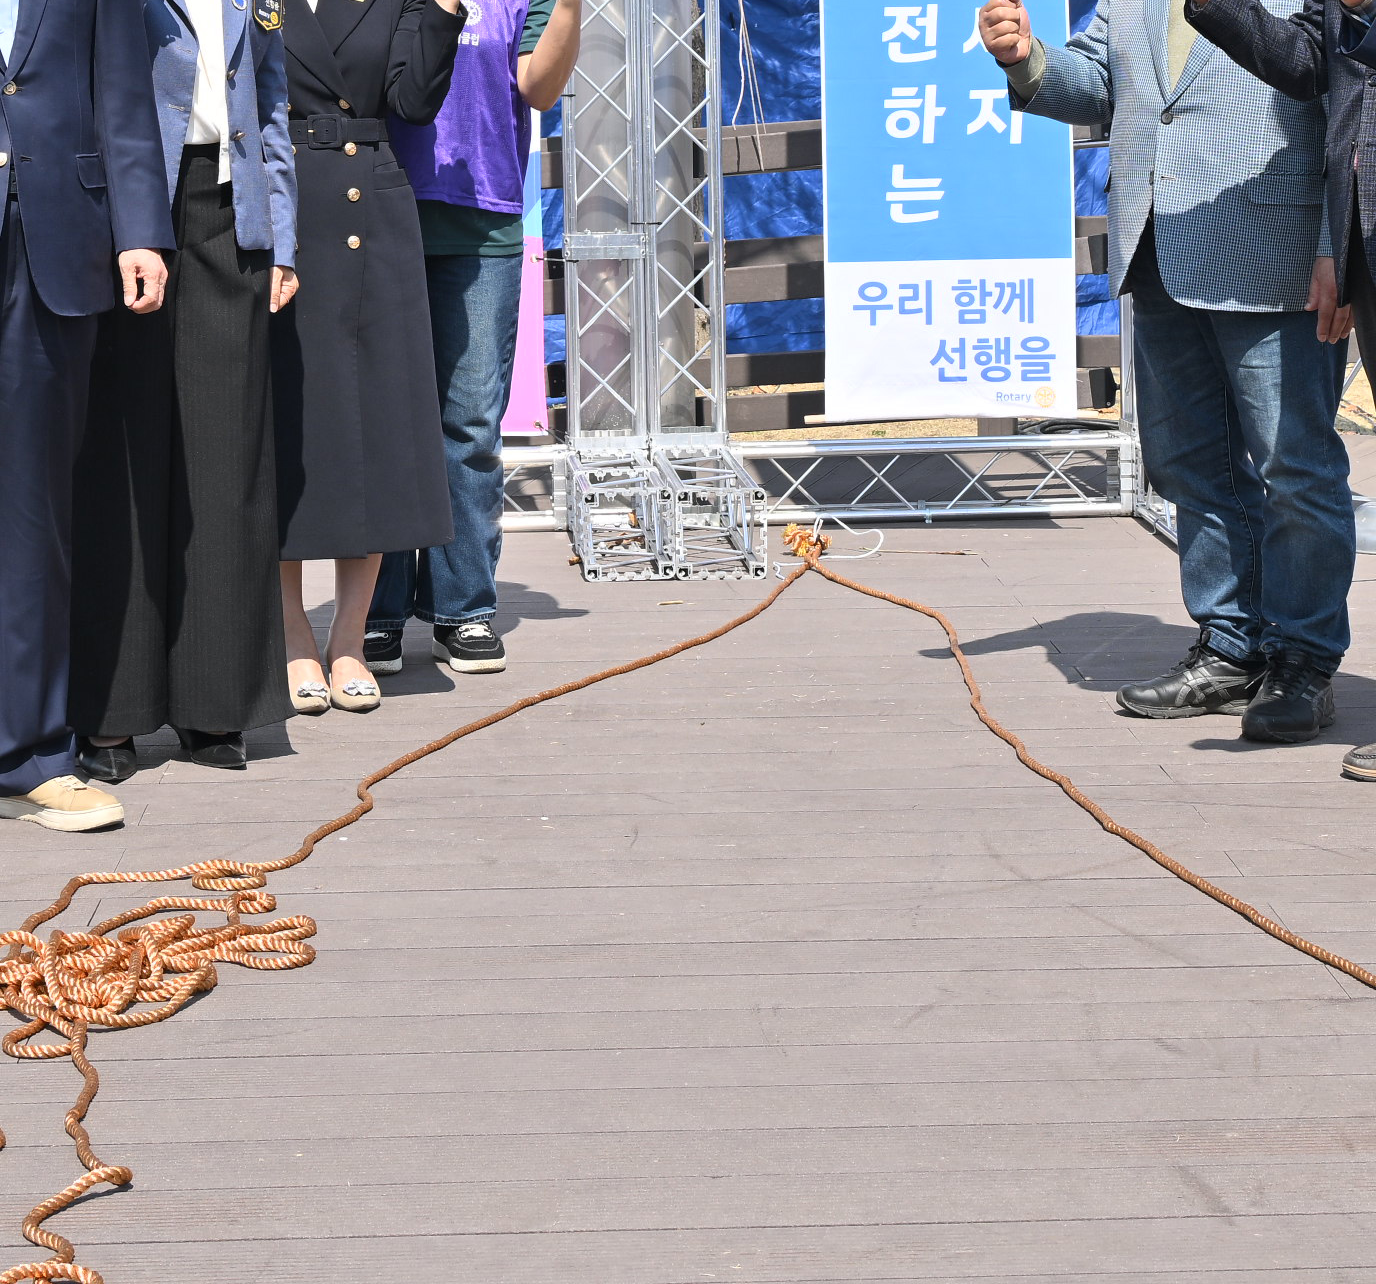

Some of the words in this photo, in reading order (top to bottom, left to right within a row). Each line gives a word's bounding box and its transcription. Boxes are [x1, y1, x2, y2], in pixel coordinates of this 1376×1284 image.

[458, 31, 480, 46] 클럽
[881, 4, 946, 224] 전하는
[852, 279, 934, 327] 우리
[951, 277, 1035, 326] 함께
[929, 335, 1057, 384] 선행을
[996, 391, 1032, 403] Rotary
